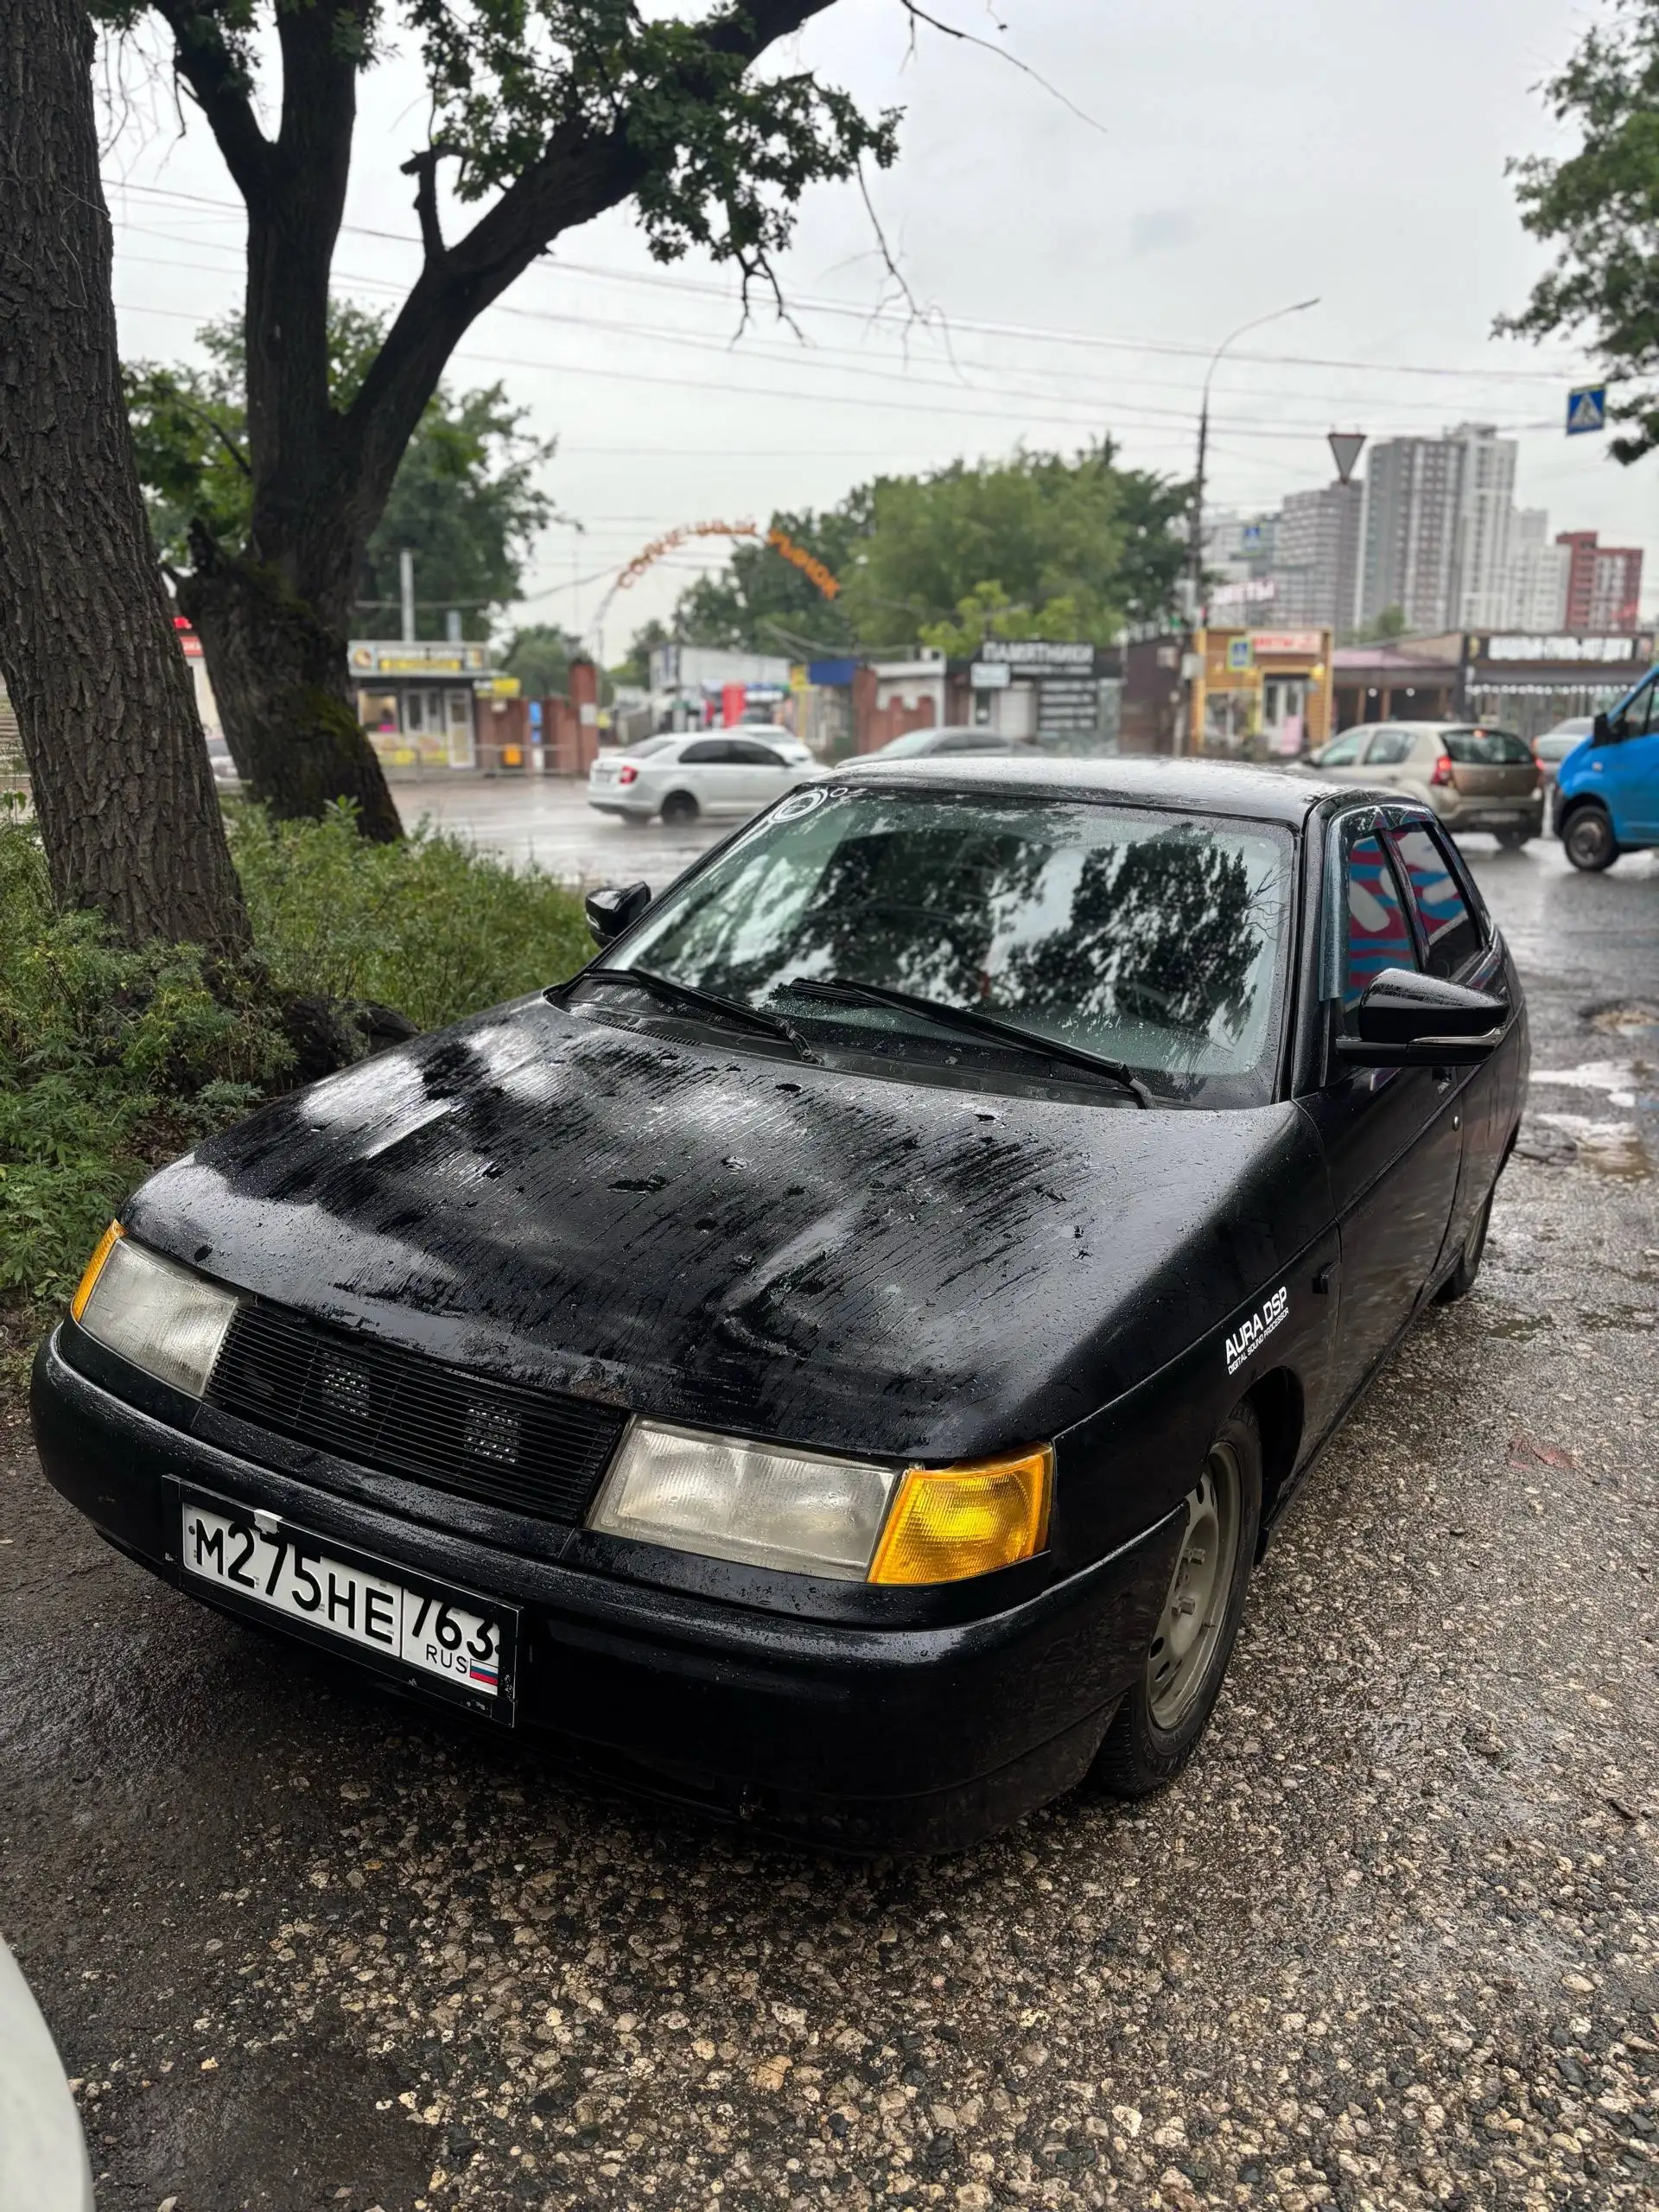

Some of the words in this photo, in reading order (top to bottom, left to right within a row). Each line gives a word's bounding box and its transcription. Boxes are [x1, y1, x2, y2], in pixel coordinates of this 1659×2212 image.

[1225, 1313, 1263, 1365] AURA
[1262, 1286, 1287, 1325] DSP
[1228, 1351, 1248, 1376] DIGITAL
[1247, 1333, 1264, 1357] SOUND
[1263, 1306, 1289, 1338] PROCESSOR
[195, 1517, 394, 1645] М275НЕ
[410, 1591, 495, 1662] 763
[425, 1643, 467, 1675] RUS
